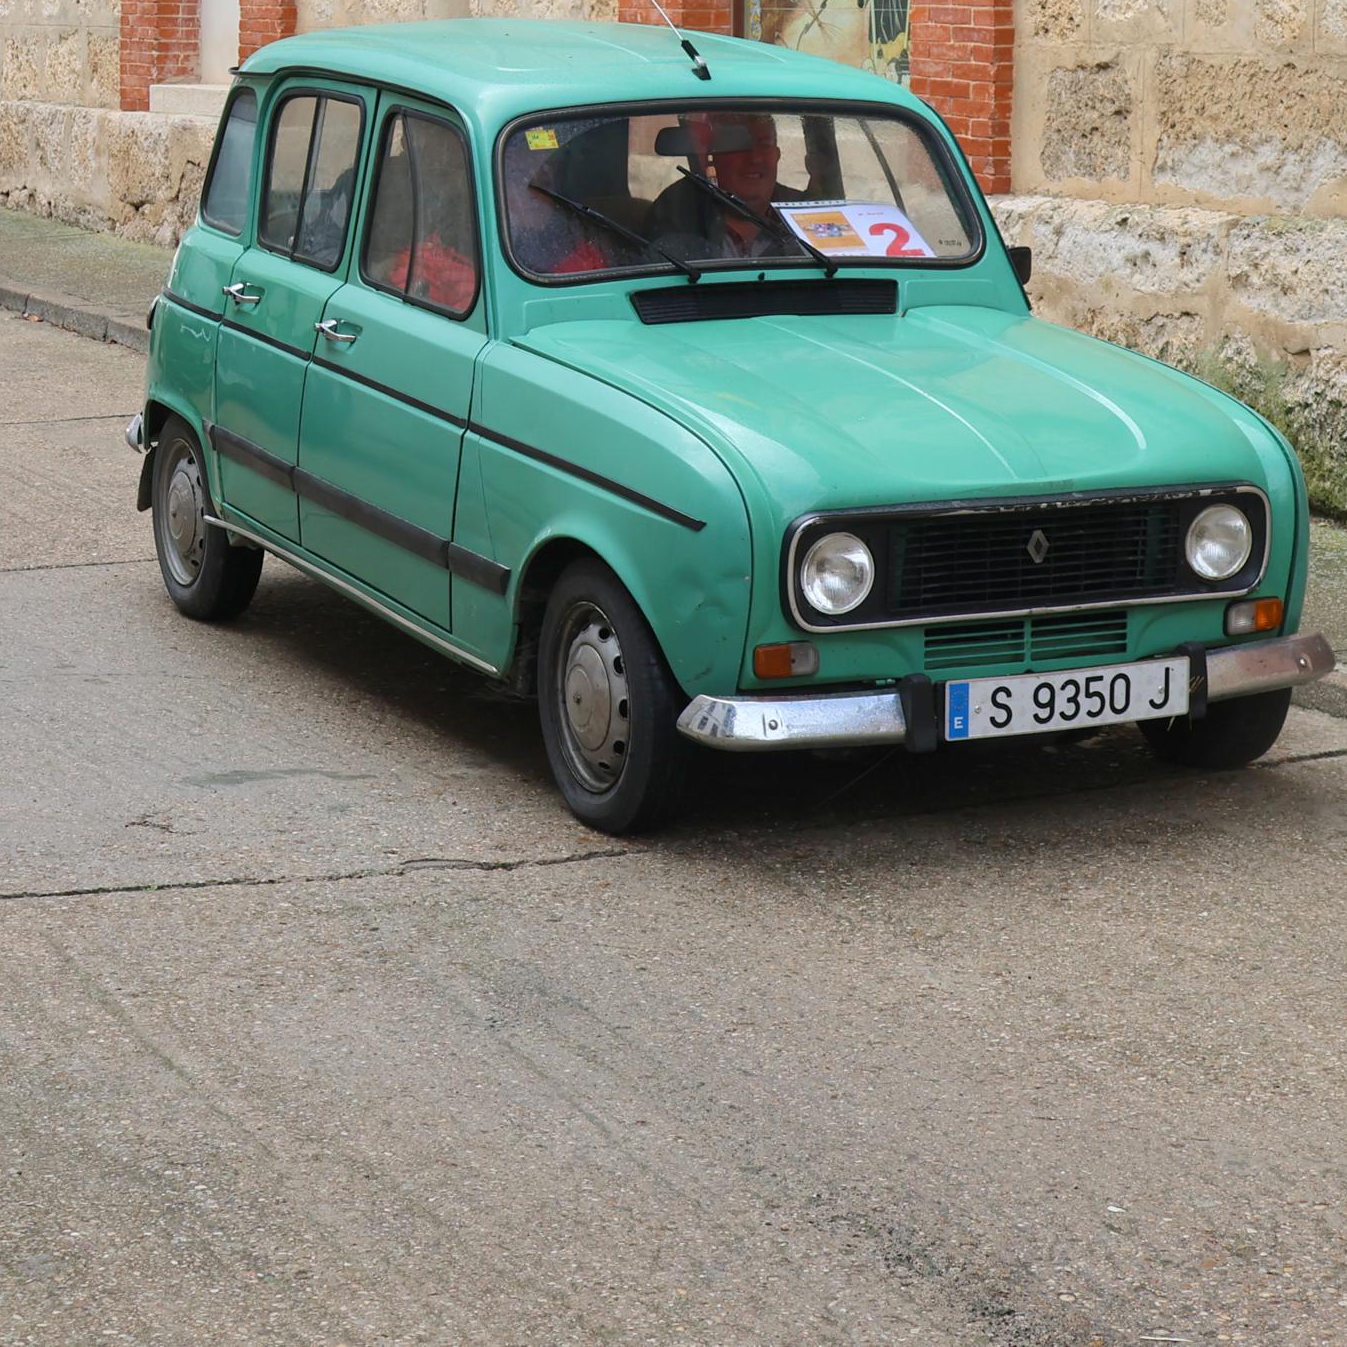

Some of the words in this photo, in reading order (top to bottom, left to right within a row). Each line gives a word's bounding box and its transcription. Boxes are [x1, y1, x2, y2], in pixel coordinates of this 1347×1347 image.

[868, 222, 926, 257] 2
[954, 716, 964, 729] E
[989, 686, 1013, 729] S
[1032, 673, 1132, 725] 9350
[1148, 666, 1171, 710] J
